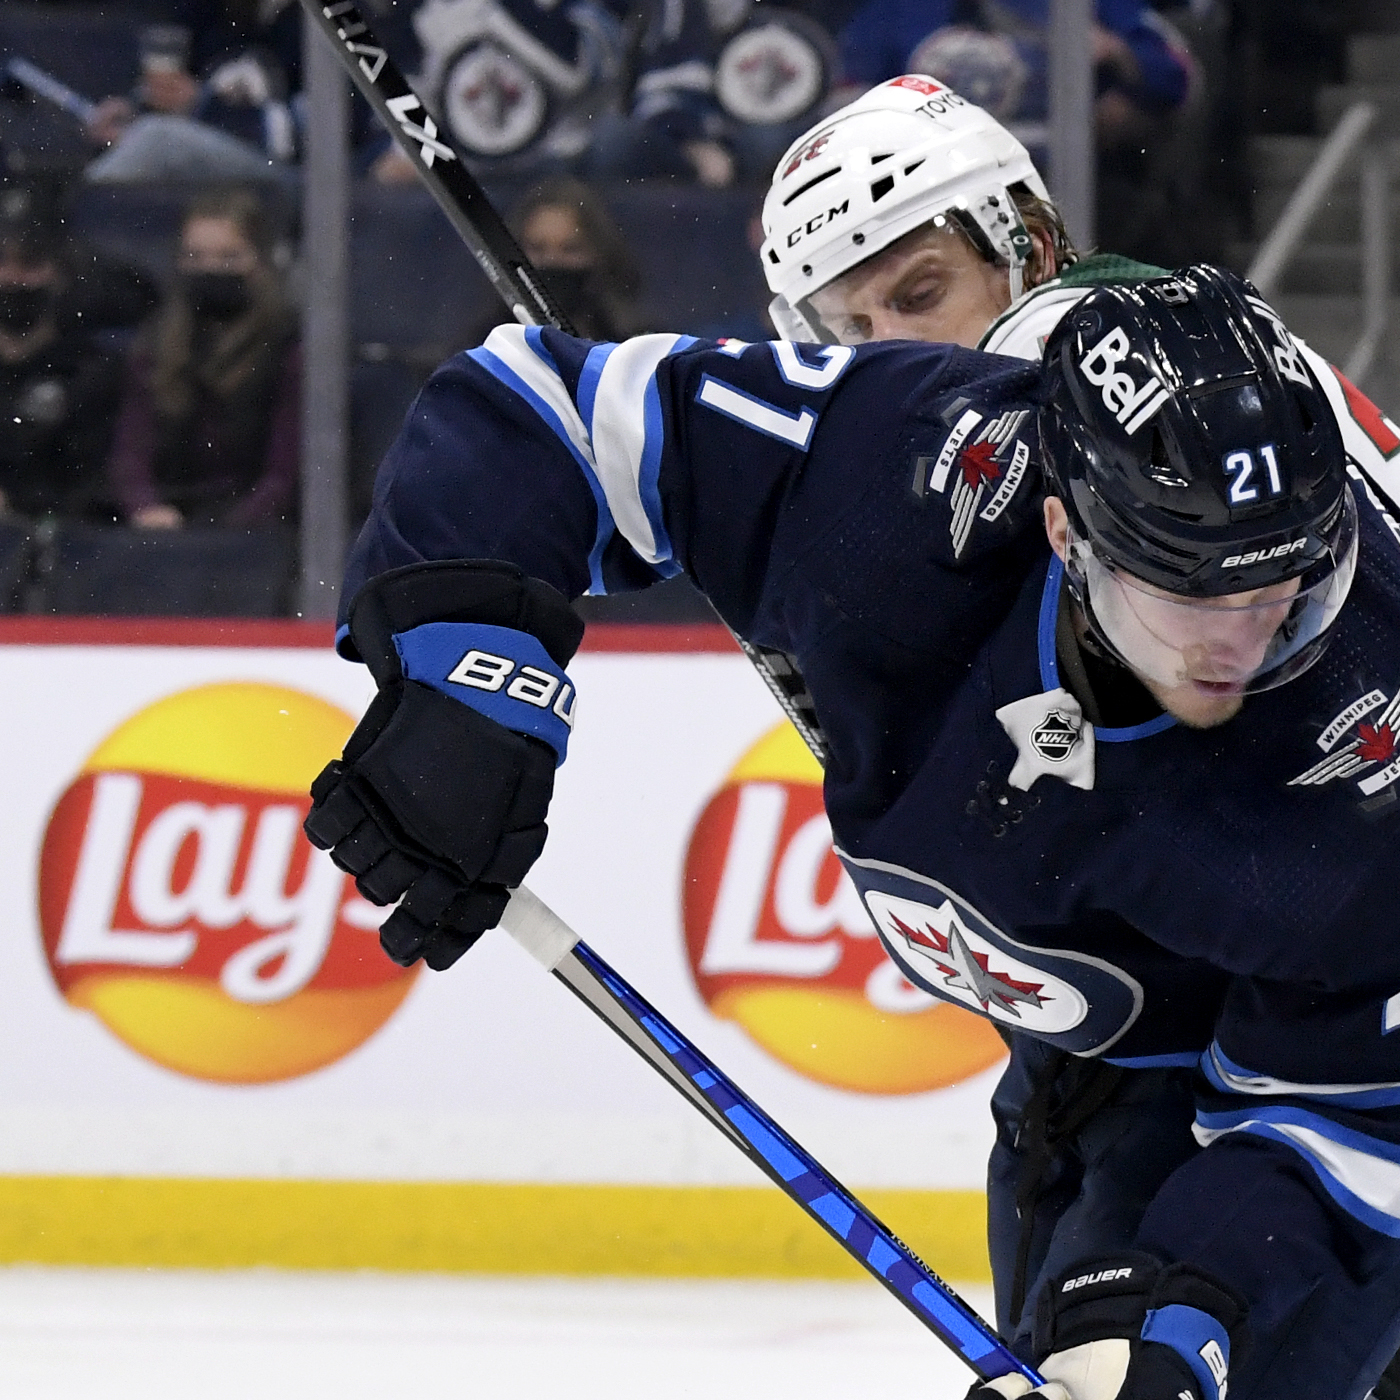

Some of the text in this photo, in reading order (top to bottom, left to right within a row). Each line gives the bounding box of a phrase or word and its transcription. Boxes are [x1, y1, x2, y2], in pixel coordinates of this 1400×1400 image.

[915, 93, 965, 119] TOYO
[787, 199, 850, 248] CCM
[1079, 325, 1170, 436] Bell
[937, 427, 965, 470] JETS
[1223, 444, 1284, 505] 21
[984, 447, 1027, 518] WINNIPEG
[446, 649, 579, 731] BAU
[1036, 732, 1071, 745] NHL
[1322, 692, 1382, 745] WINNIPEG
[889, 1231, 957, 1297] TONINATO
[1061, 1267, 1133, 1293] BAUER
